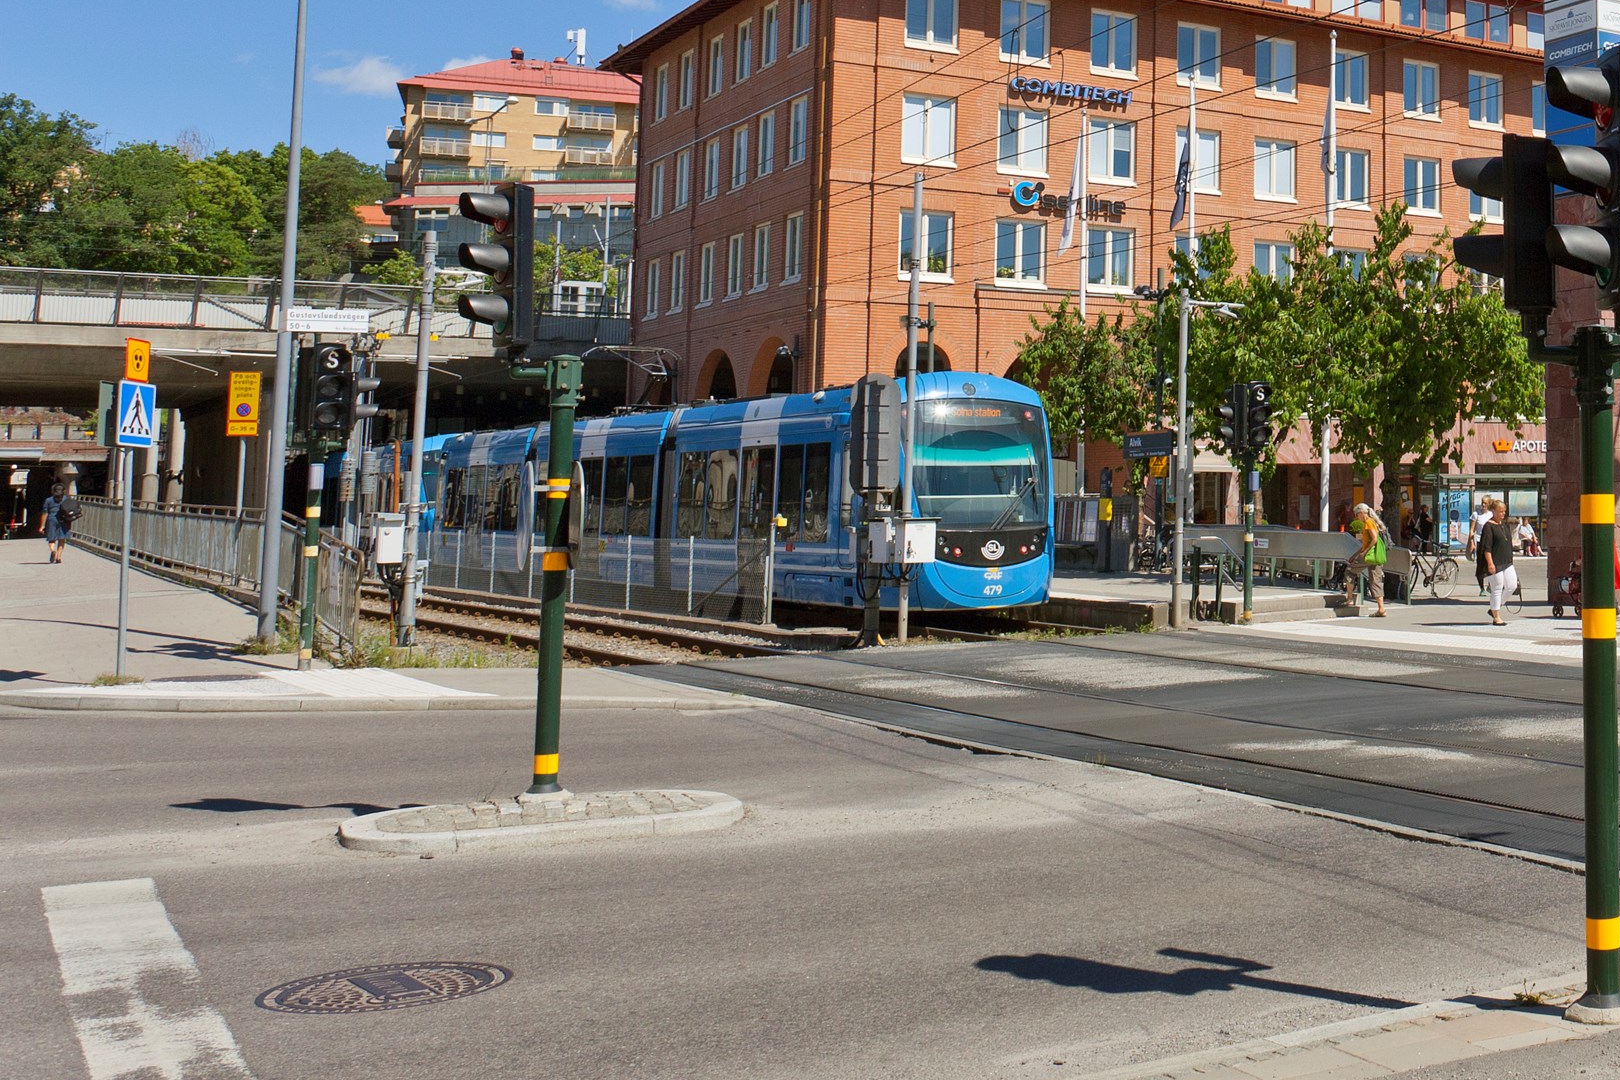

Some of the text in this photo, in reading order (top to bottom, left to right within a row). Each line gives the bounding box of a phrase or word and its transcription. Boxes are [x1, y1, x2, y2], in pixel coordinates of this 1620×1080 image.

[1549, 41, 1593, 60] COMBITECH
[1011, 76, 1133, 105] COMBITECH
[289, 311, 365, 321] Gustavslundsvägen
[326, 350, 339, 369] S
[1256, 387, 1265, 401] S
[974, 407, 1001, 417] station
[1129, 437, 1142, 447] Alvik
[987, 543, 998, 552] SL
[984, 572, 1003, 580] CAF
[983, 584, 1003, 595] 479
